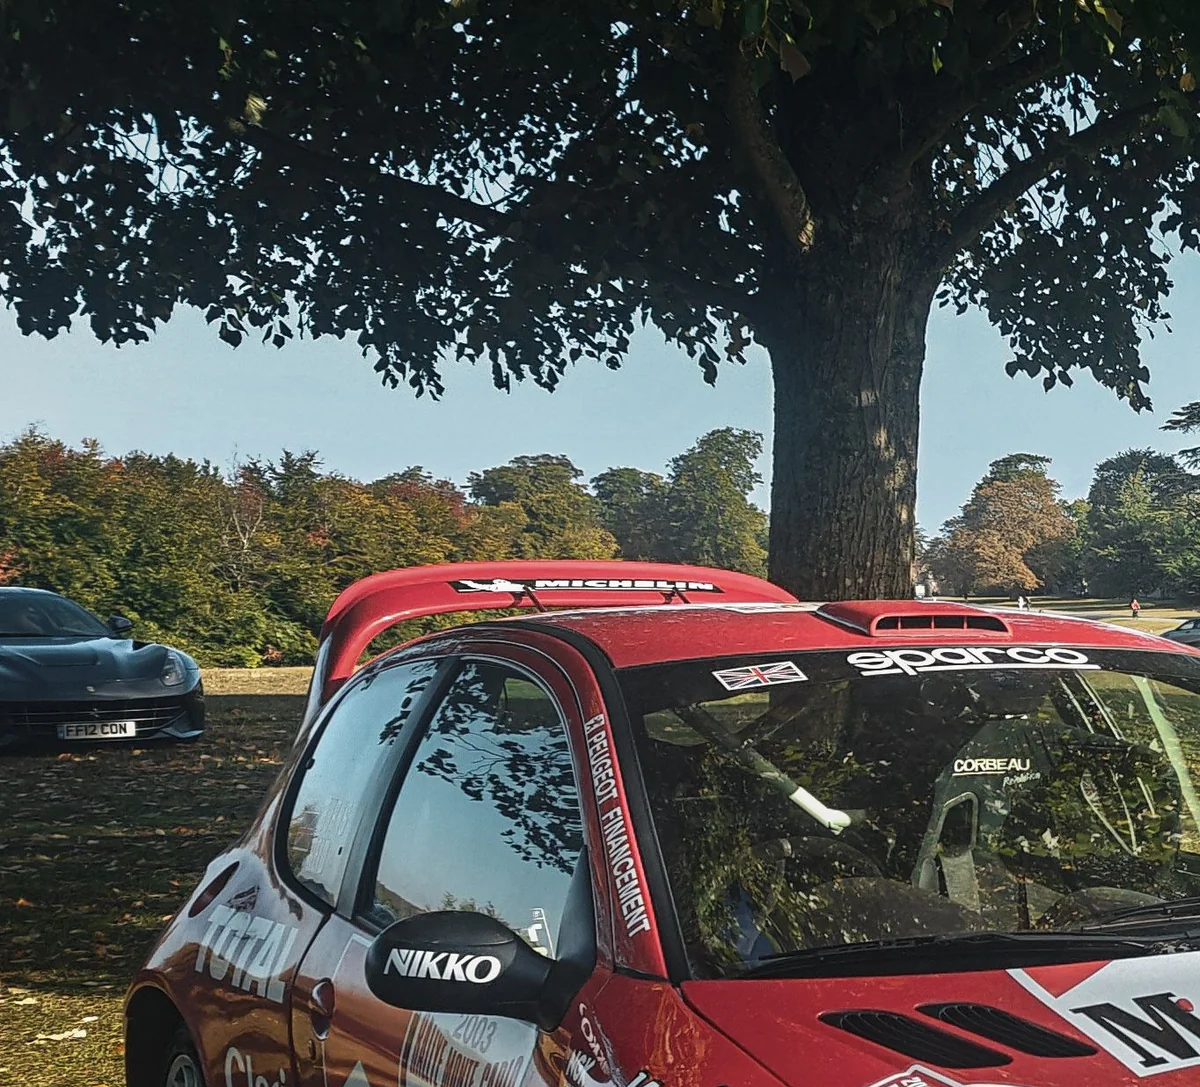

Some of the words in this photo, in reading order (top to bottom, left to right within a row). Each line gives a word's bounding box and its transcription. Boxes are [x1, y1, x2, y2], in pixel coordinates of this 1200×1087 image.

[534, 579, 715, 591] MICHELIN
[846, 646, 1090, 676] sparco
[65, 723, 98, 737] FF12
[586, 730, 618, 806] PEUGEOT
[953, 758, 1031, 772] CORBEAU
[601, 806, 651, 937] FINANCEMENT
[194, 904, 299, 1004] TOTAL
[383, 948, 501, 984] NIKKO
[452, 1014, 498, 1054] 2003
